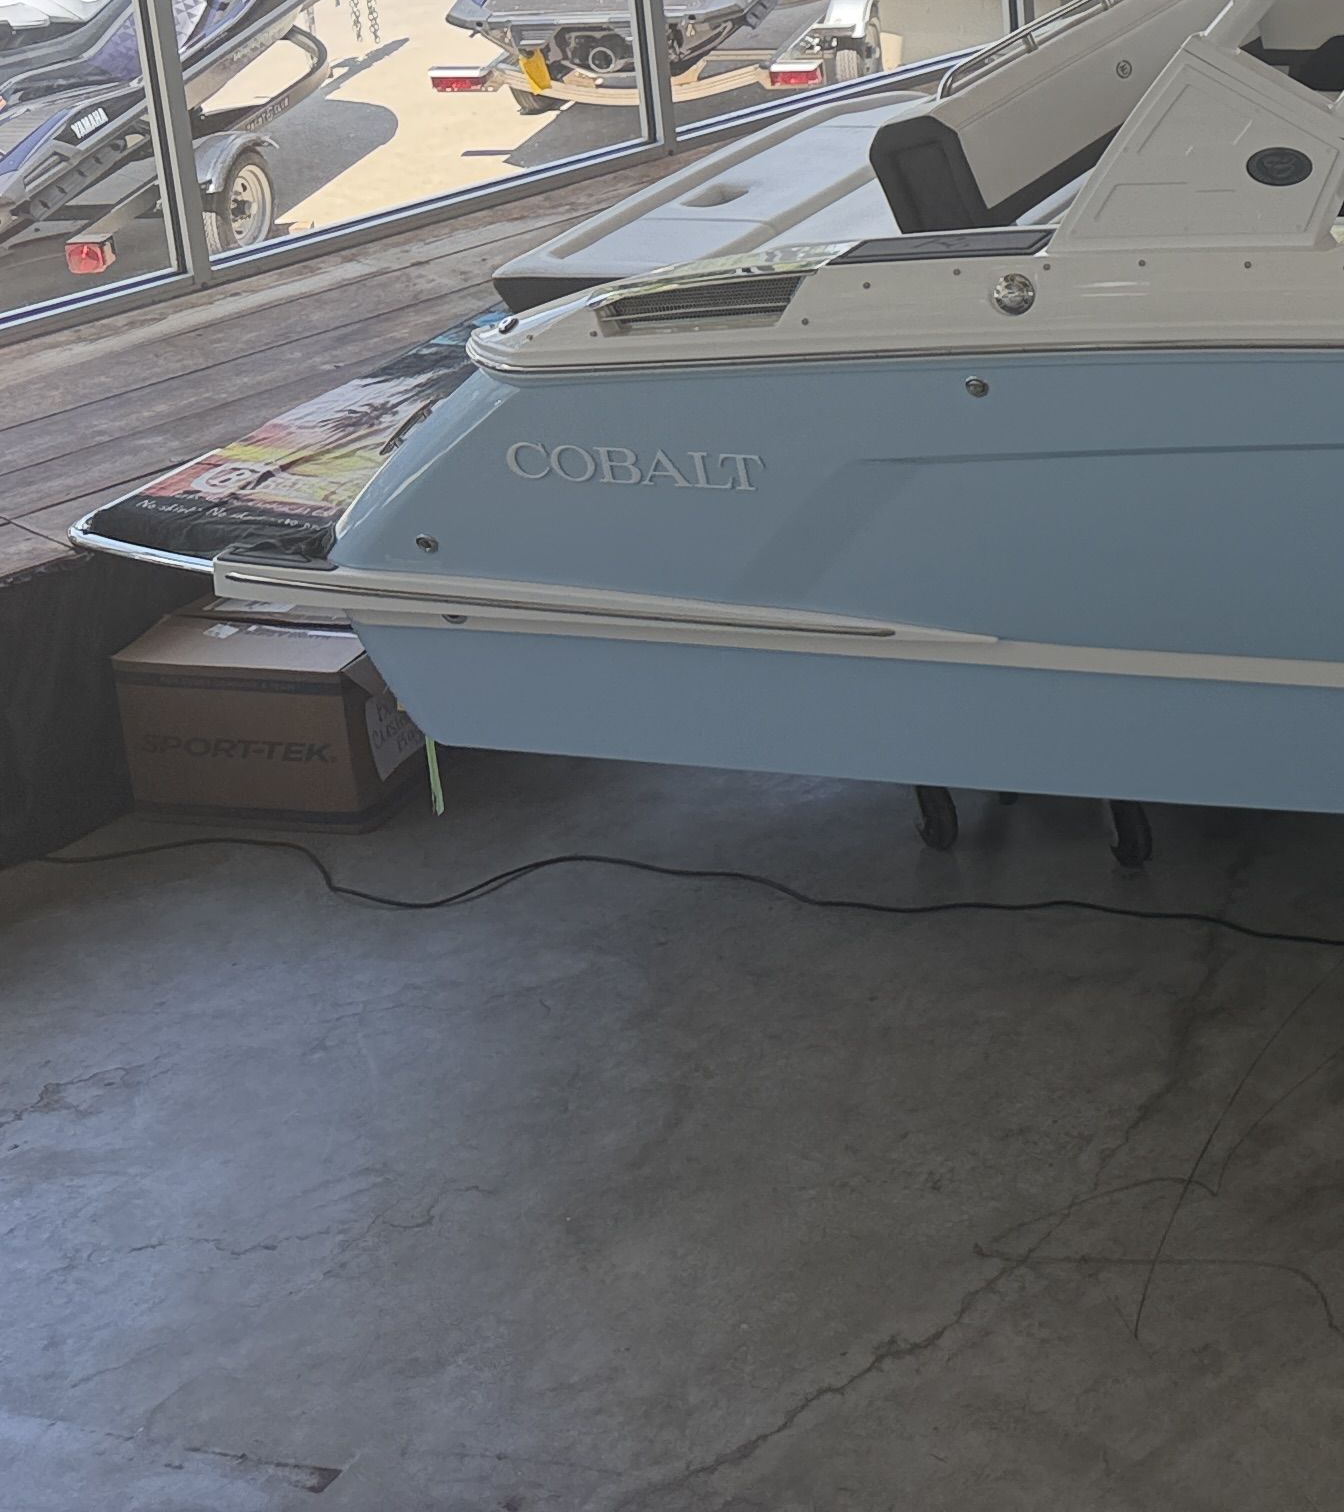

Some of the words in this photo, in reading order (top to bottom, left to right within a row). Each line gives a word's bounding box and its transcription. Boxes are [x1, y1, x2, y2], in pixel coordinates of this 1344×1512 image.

[70, 107, 109, 139] YAMAHA
[505, 441, 766, 492] COBALT
[141, 733, 335, 763] SPORT-TEK
